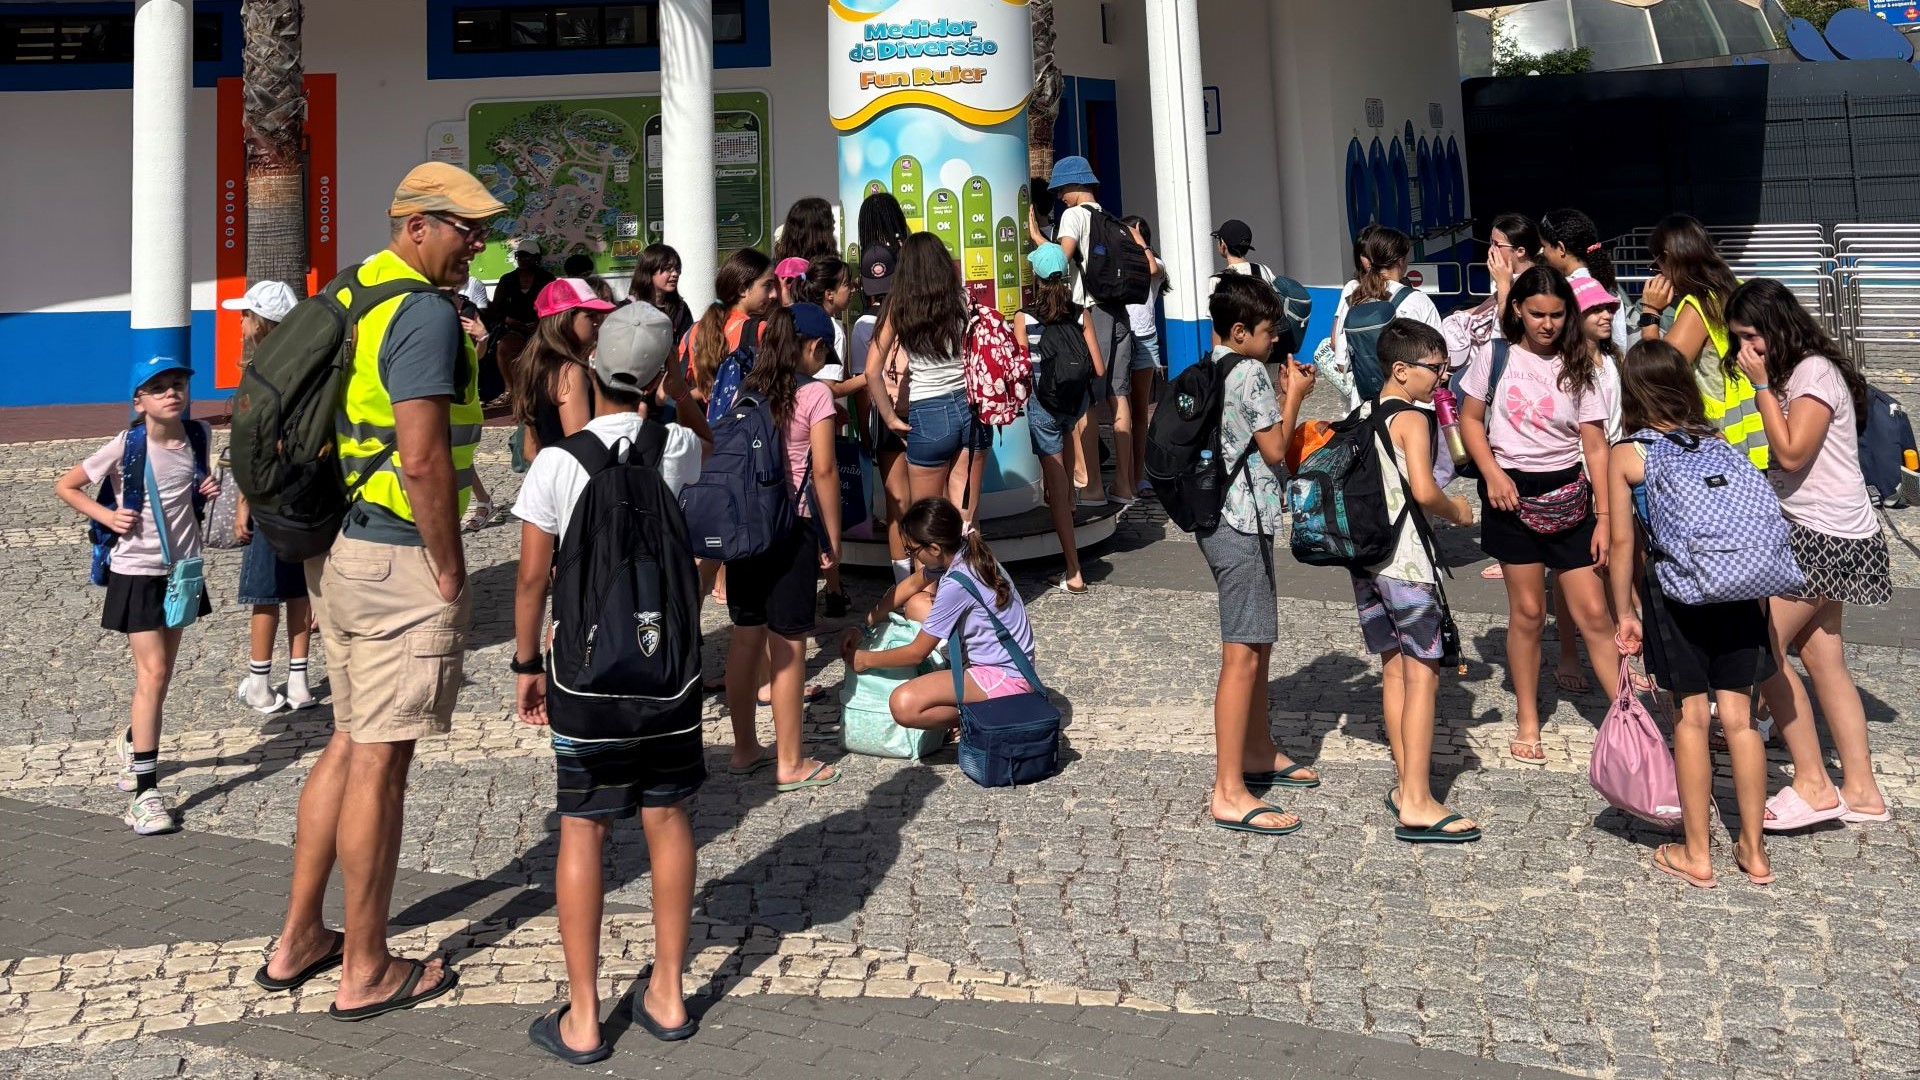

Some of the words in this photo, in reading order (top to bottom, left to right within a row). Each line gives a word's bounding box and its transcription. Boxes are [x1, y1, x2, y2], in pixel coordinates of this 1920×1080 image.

[863, 18, 977, 41] Medidor
[849, 43, 876, 62] de
[877, 36, 998, 60] Diversão
[859, 70, 910, 90] Fun
[912, 65, 987, 87] Ruler
[900, 183, 914, 193] OK
[972, 213, 985, 222] OK
[936, 221, 951, 231] OK
[1003, 254, 1013, 263] OK
